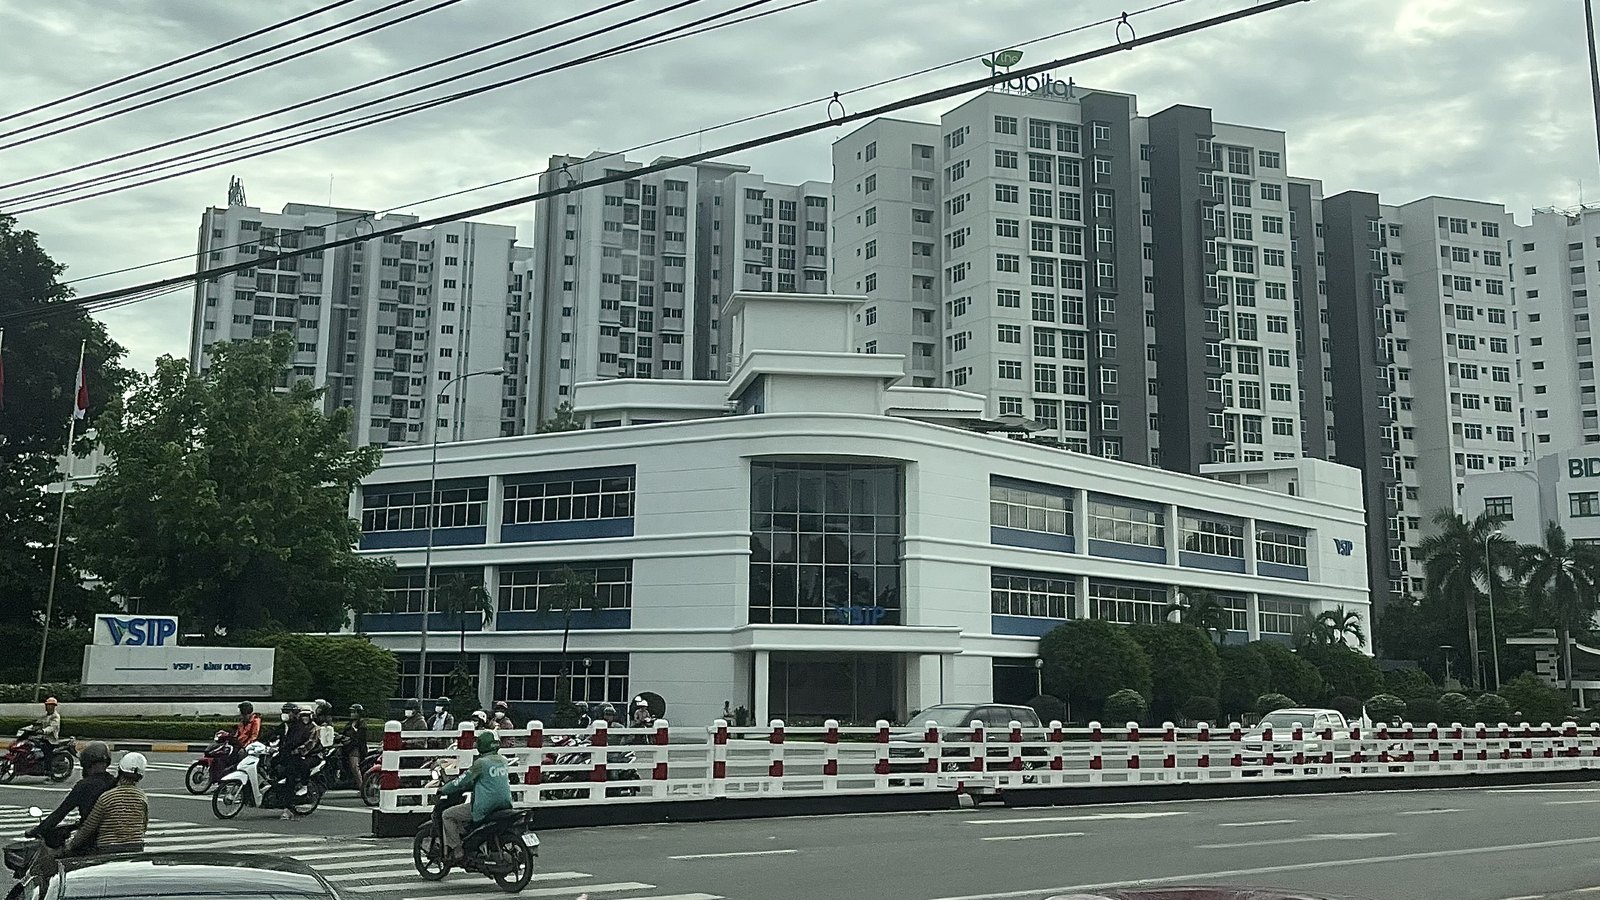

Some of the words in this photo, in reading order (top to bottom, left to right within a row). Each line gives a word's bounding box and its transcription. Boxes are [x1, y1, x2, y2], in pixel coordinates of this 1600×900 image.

[1000, 53, 1019, 63] the
[1333, 538, 1353, 556] VSIP
[99, 617, 176, 645] VSIP
